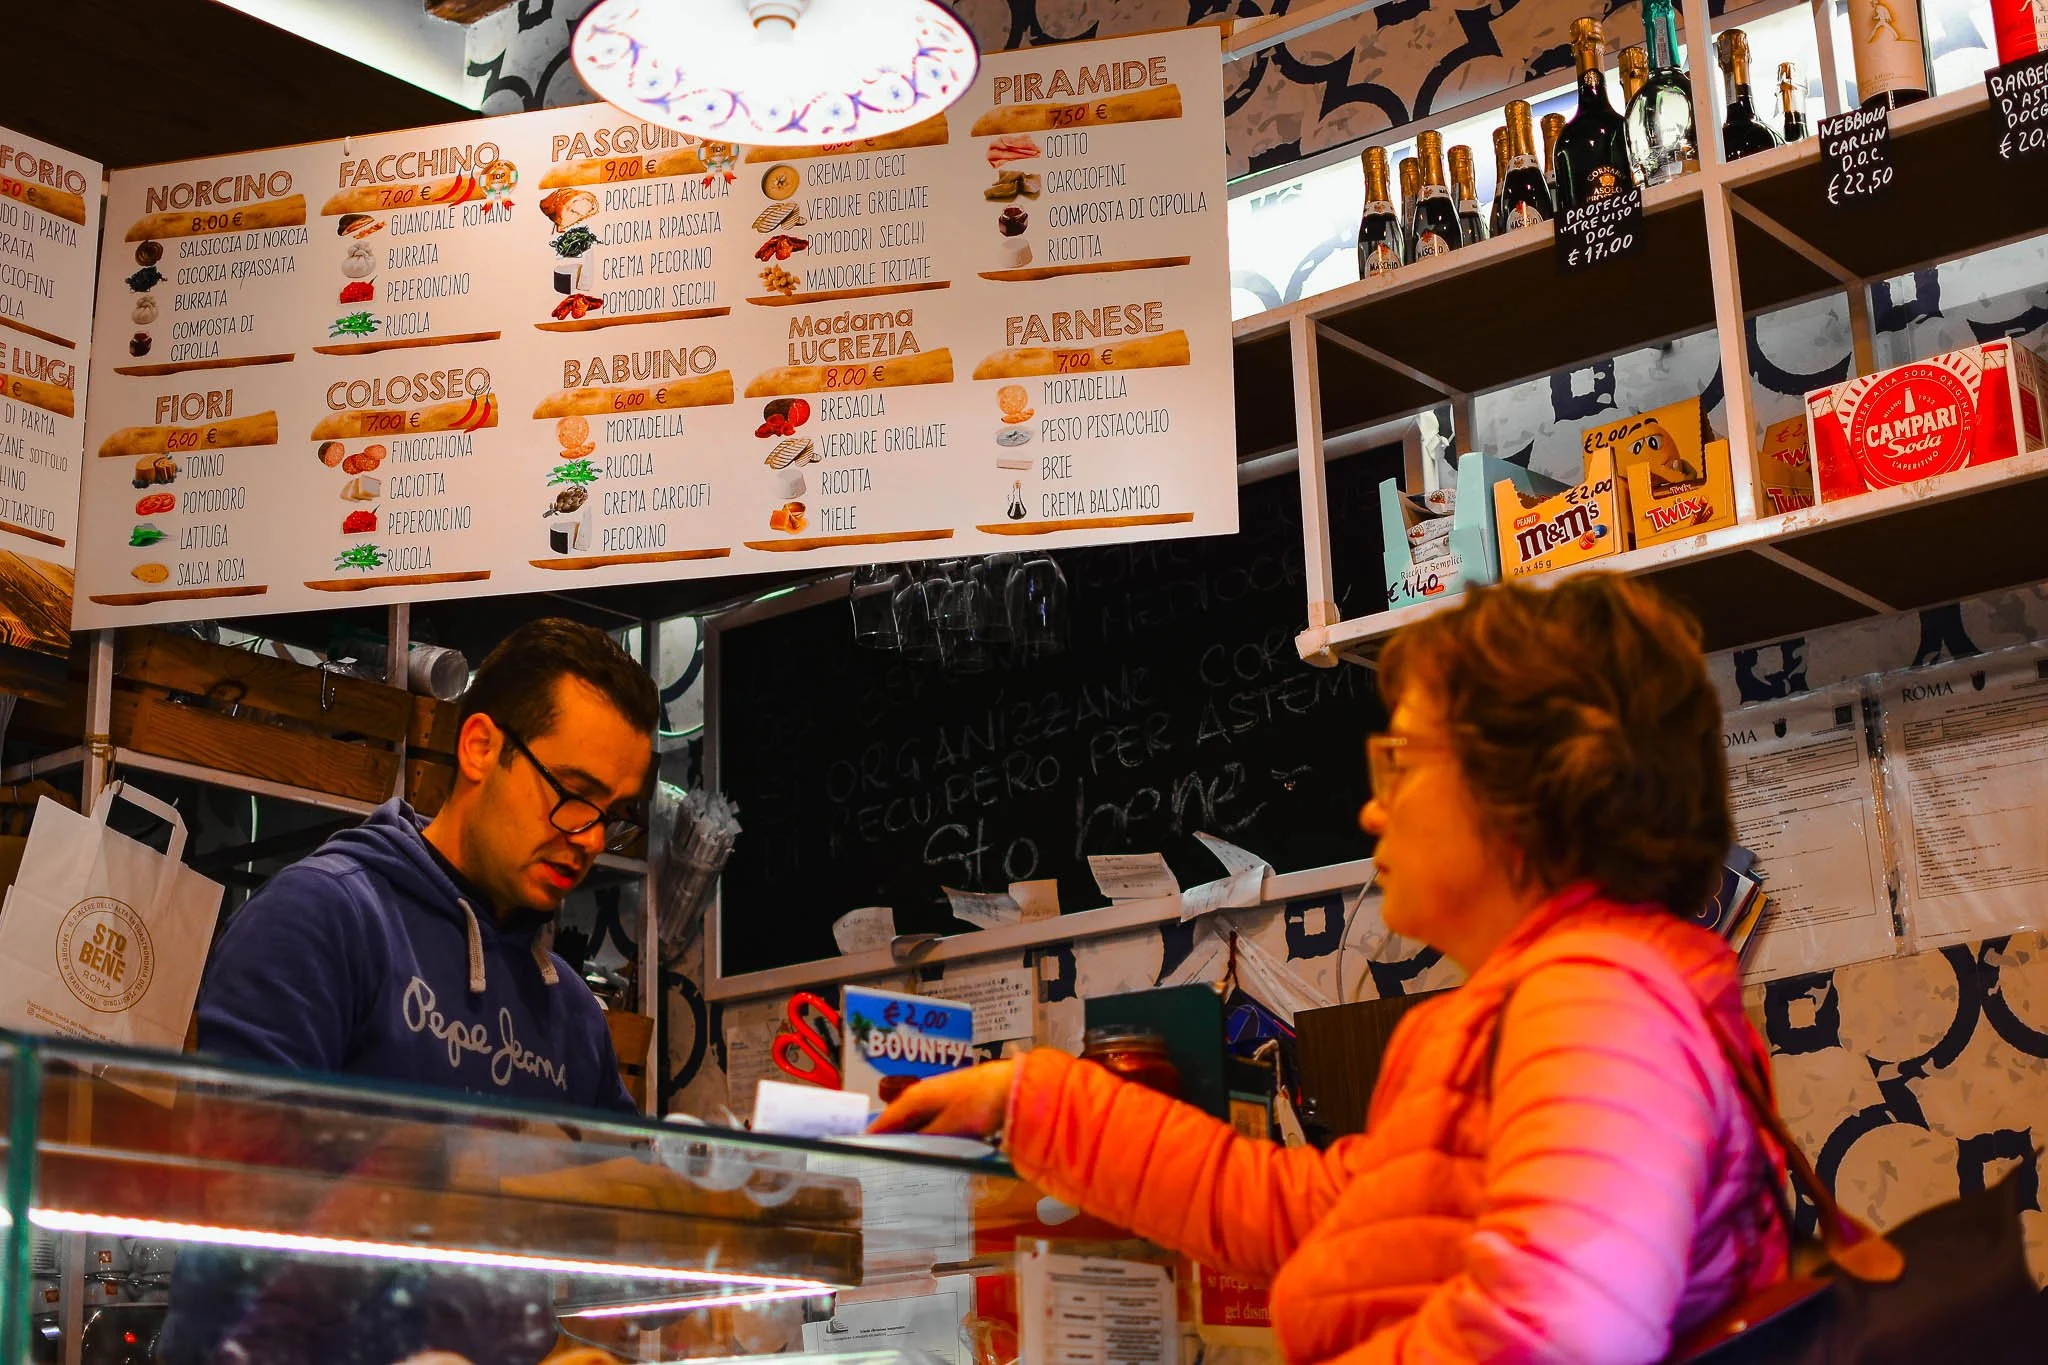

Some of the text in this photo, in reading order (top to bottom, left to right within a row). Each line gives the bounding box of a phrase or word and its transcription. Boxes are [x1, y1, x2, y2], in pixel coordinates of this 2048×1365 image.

[993, 55, 1168, 105] PIRAMIDE
[1821, 105, 1887, 140] NEBBIOLO
[1046, 131, 1088, 159] COTTO
[338, 141, 500, 189] FACCHINO
[807, 154, 907, 187] CREMA DI CECI
[1047, 163, 1128, 194] CARCIOFINI
[1844, 166, 1893, 194] 22,50
[145, 170, 293, 213] NORCINO
[605, 182, 675, 212] PORCHETTA
[806, 185, 930, 221] VERDURE GRIGLIATE
[1566, 189, 1639, 225] PROSECCO
[391, 207, 456, 237] GUANCIALE
[1049, 191, 1208, 228] COMPOSTA DI CIPOLLA
[40, 216, 78, 249] PARMA
[179, 227, 308, 258] SALSICCIA DI NORCIA
[603, 211, 721, 246] CICORIA RIPASSATA
[806, 220, 925, 257] POMODORI SECCHI
[1585, 224, 1615, 245] DOC
[388, 243, 439, 270] BURRATA
[1048, 233, 1103, 262] RICOTTA
[1584, 233, 1634, 264] 17,00
[177, 256, 296, 286] CICORIA RIPASSATA
[602, 246, 712, 281] CREMA PECORINO
[806, 256, 931, 291] MANDORLE TRITATE
[174, 289, 228, 312] BURRATA
[386, 271, 471, 303] PEPERONCINO
[602, 280, 716, 315] POMODORI SECCHI
[172, 314, 255, 340] COMPOSTA DI
[385, 311, 431, 337] RUCOLA
[788, 308, 913, 339] Madama
[1006, 301, 1164, 346] FARNESE
[170, 340, 220, 362] CIPOLLA
[788, 330, 920, 366] LUCREZIA
[12, 347, 75, 390] LUIGI
[563, 345, 717, 388] BABUINO
[826, 368, 867, 388] 8,00
[326, 367, 491, 411] COLOSSEO
[1044, 375, 1128, 405] MORTADELLA
[1873, 376, 1897, 398] ALLA
[1904, 369, 1933, 378] SODA
[1940, 374, 1971, 432] ORIGINALE
[5, 402, 56, 437] DI PARMA
[155, 388, 234, 425] FIORI
[821, 393, 885, 421] BRESAOLA
[166, 431, 199, 449] 6,00
[606, 413, 684, 443] MORTADELLA
[820, 423, 947, 458] VERDURE GRIGLIATE
[1041, 408, 1170, 443] PESTO PISTACCHIO
[1865, 404, 1958, 448] CAMPARI
[391, 433, 473, 464] FINOCCHIONA
[1882, 433, 1943, 460] Soda
[185, 453, 226, 480] TONNO
[605, 453, 654, 480] RUCOLA
[821, 468, 872, 496] RICOTTA
[1042, 454, 1073, 480] BRIE
[182, 486, 246, 514] POMODORO
[389, 472, 446, 500] CACIOTTA
[603, 482, 711, 516] CREMA CARCIOFI
[1042, 483, 1161, 518] CREMA BALSAMICO
[12, 500, 55, 532] TARTUFO
[388, 505, 472, 536] PEPERONCINO
[821, 505, 858, 533] MIELE
[1515, 514, 1538, 528] PEANUT
[1644, 496, 1702, 532] Twix
[180, 524, 229, 550] LATTUGA
[603, 523, 667, 552] PECORINO
[177, 557, 246, 586] SALSA ROSA
[387, 546, 432, 572] RUCOLA
[1431, 554, 1463, 573] Semplici
[1513, 561, 1545, 576] 24 45
[1402, 573, 1439, 599] 1,40
[1902, 680, 1954, 704] ROMA
[92, 923, 127, 953] STO
[79, 939, 127, 984] BENE
[82, 969, 112, 991] ROMA
[403, 975, 493, 1068] Pepe
[905, 1003, 949, 1034] 2,00
[868, 1030, 968, 1068] BOUNTY
